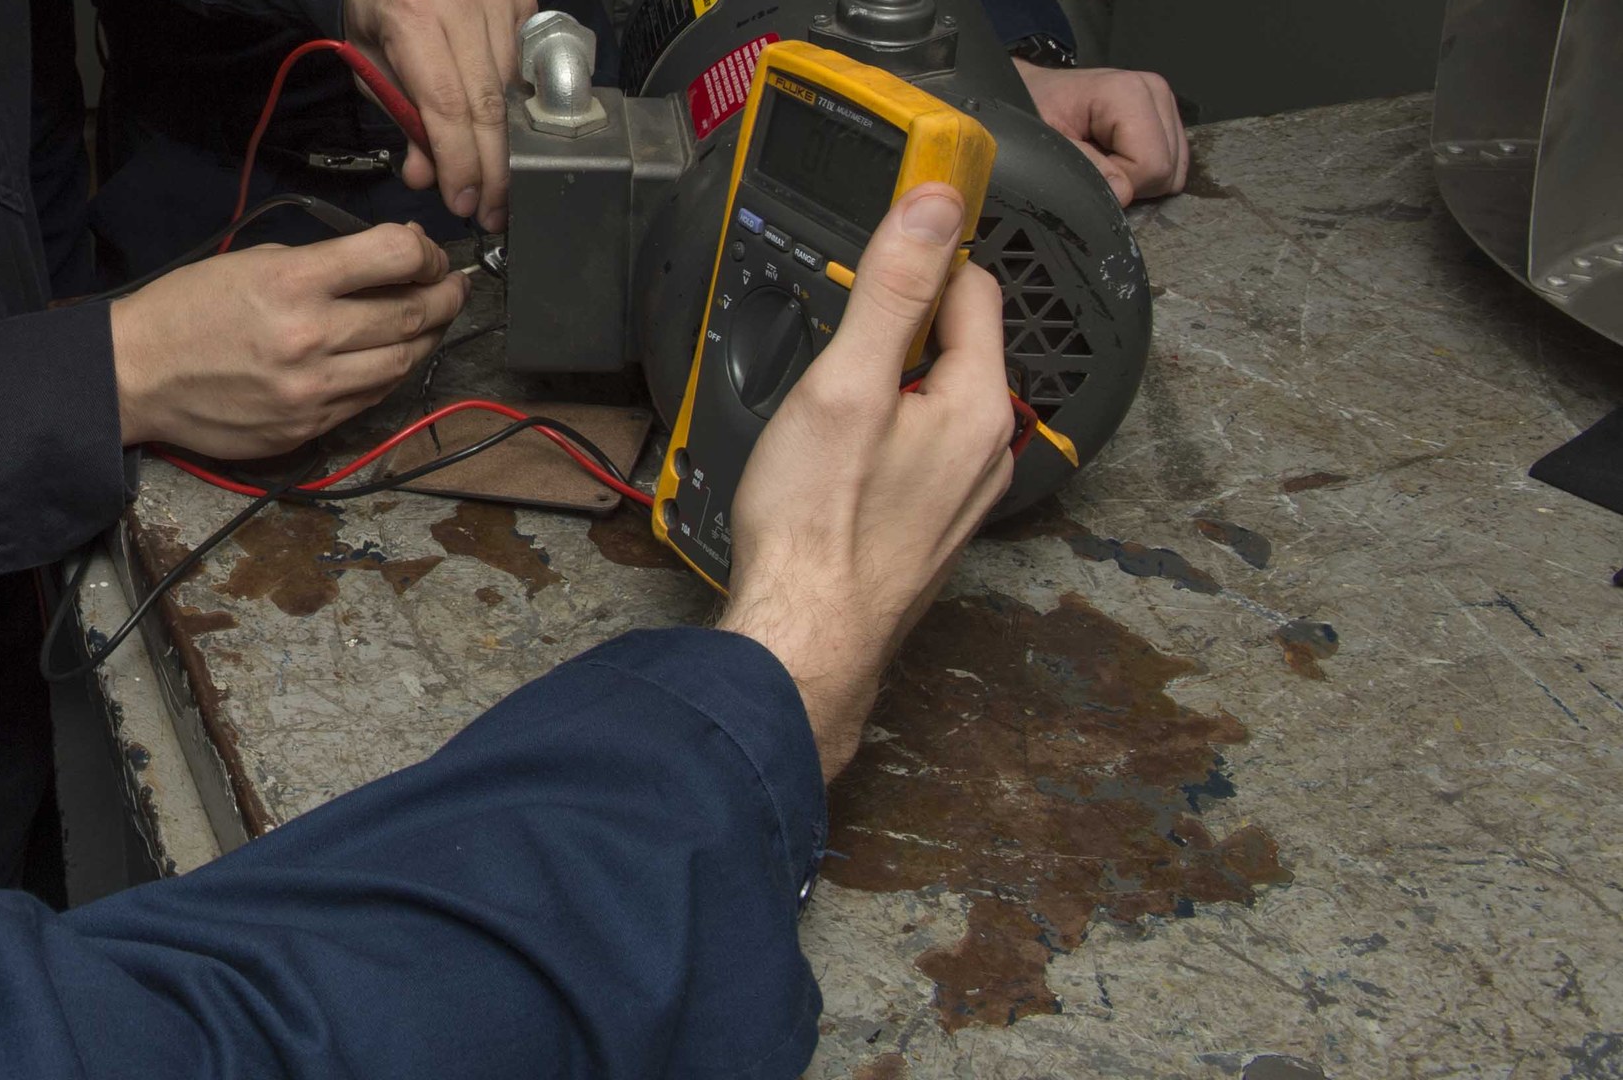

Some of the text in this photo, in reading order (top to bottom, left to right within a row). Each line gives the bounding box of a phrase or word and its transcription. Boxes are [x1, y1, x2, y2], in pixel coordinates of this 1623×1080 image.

[776, 78, 814, 102] FLUKE
[837, 105, 874, 128] MULTIMETER
[739, 215, 755, 228] HOLD
[794, 248, 817, 267] RANGE
[707, 330, 722, 343] OFF
